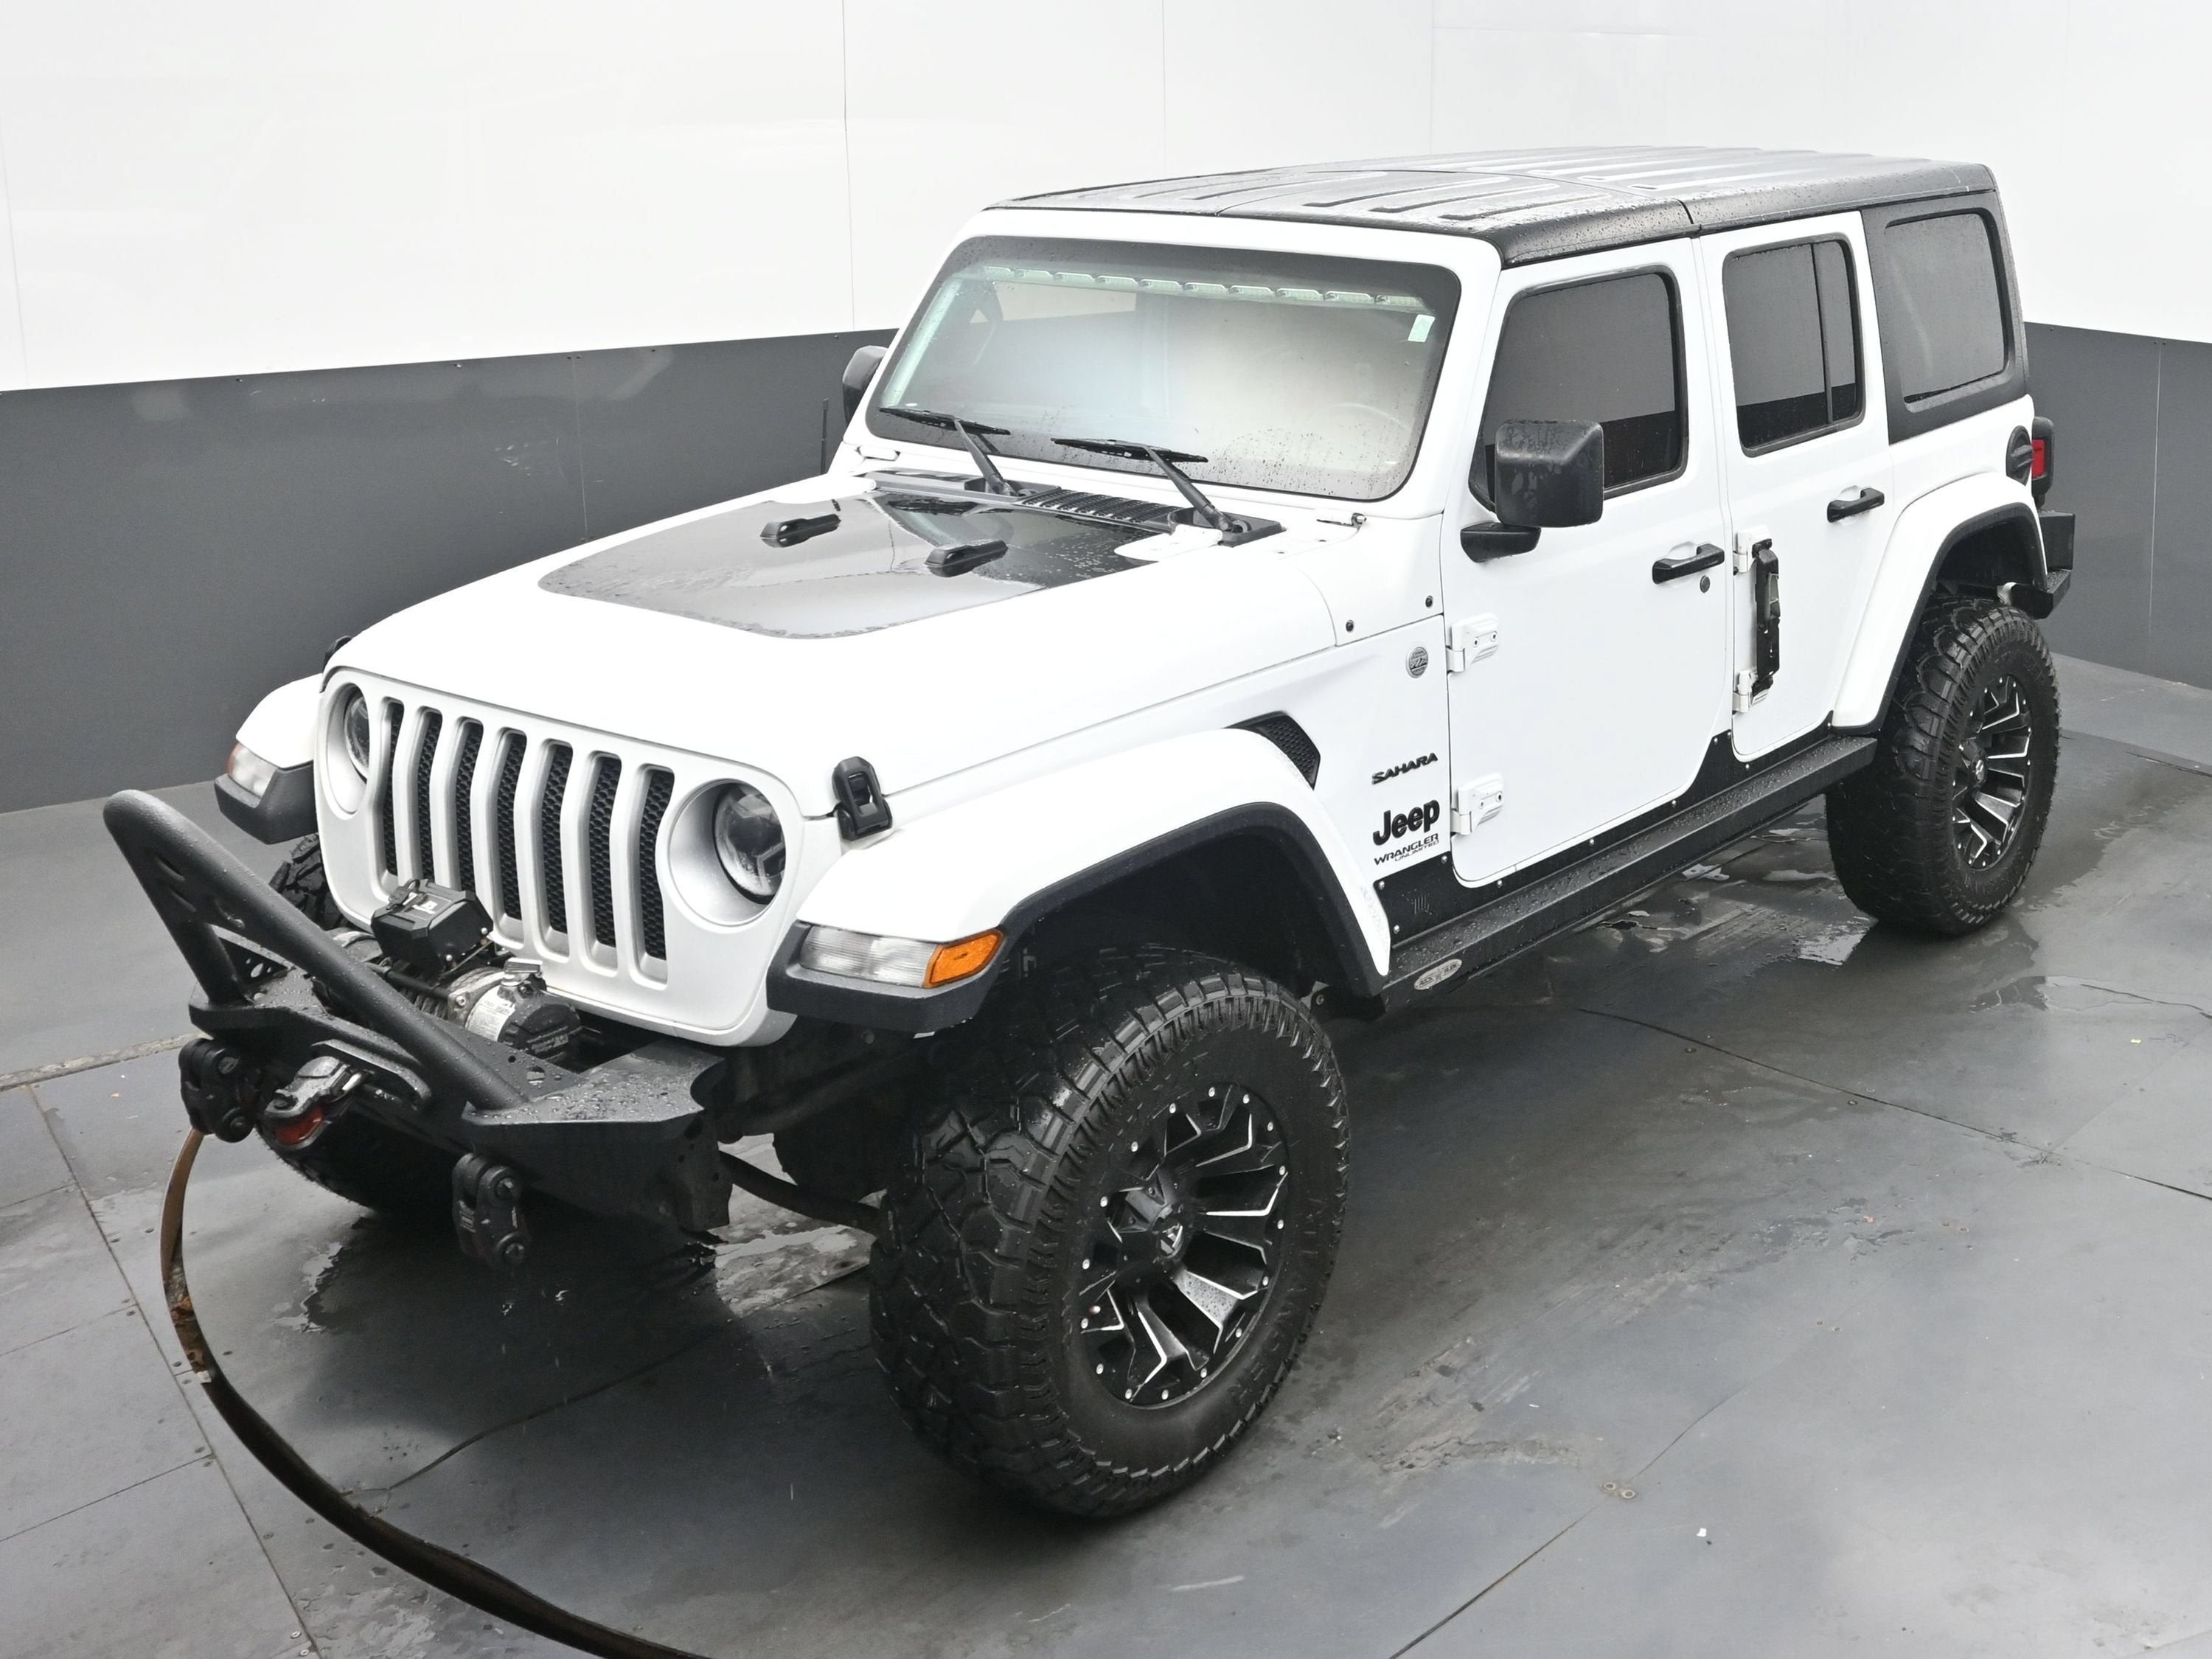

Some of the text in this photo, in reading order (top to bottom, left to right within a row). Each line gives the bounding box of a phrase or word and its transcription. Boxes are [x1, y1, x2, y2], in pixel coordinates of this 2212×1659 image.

[1371, 752, 1439, 785] SAHARA
[1372, 799, 1440, 846] Jeep
[1374, 833, 1439, 865] WRANGLER
[1394, 840, 1439, 862] UNLIMITED
